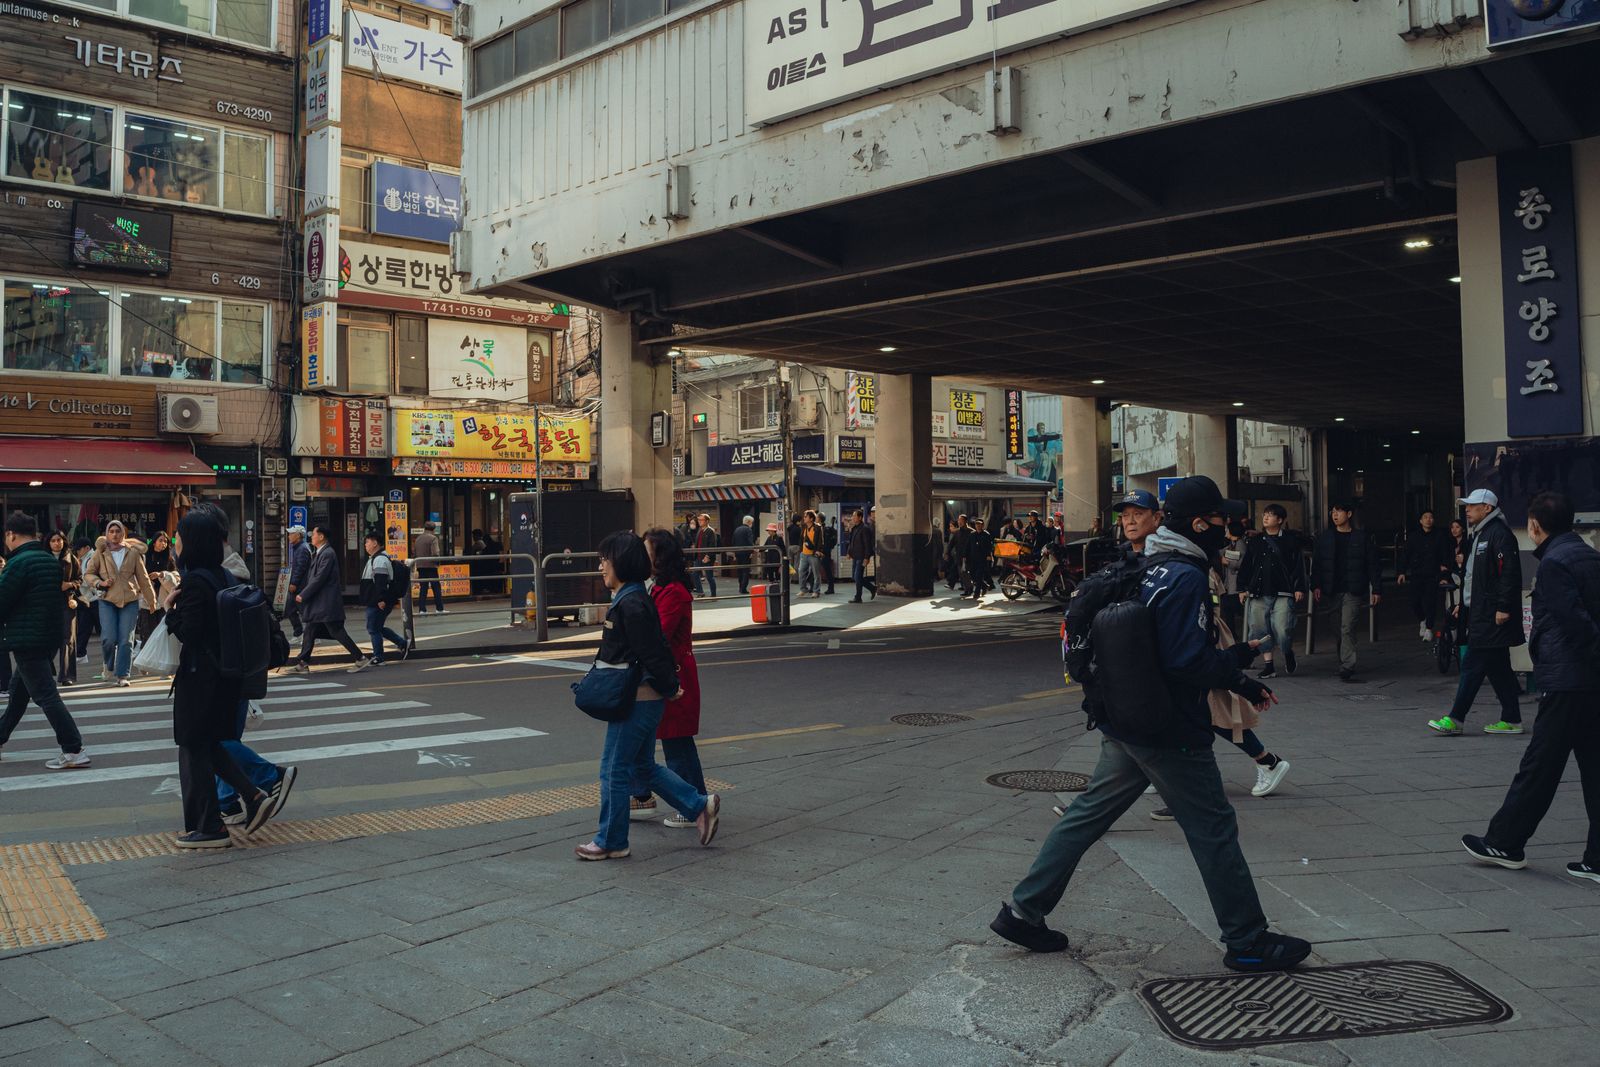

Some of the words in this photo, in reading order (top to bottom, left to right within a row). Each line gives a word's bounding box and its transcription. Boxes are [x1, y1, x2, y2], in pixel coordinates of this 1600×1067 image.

[767, 8, 807, 44] AS
[65, 35, 184, 83] 기타뮤즈
[381, 43, 399, 54] ENT
[404, 39, 453, 75] 가수
[309, 71, 327, 92] 아코
[216, 100, 272, 122] 673-4290
[309, 90, 326, 112] 디언
[47, 199, 64, 209] co.
[116, 216, 140, 237] MUSE
[1513, 186, 1558, 396] 종로양조
[422, 301, 492, 318] T.741-0590
[527, 313, 539, 324] 2F
[460, 335, 495, 358] 상록
[49, 399, 132, 415] Collection
[953, 391, 974, 409] 청춘
[464, 418, 477, 432] 신
[957, 411, 982, 425] 이발관
[349, 410, 362, 455] 전통찻집
[370, 413, 384, 448] 부동산
[478, 423, 581, 454] 한국통닭
[319, 458, 370, 472] 낙원빌딩
[932, 444, 947, 465] 집
[949, 445, 984, 467] 국밥전문
